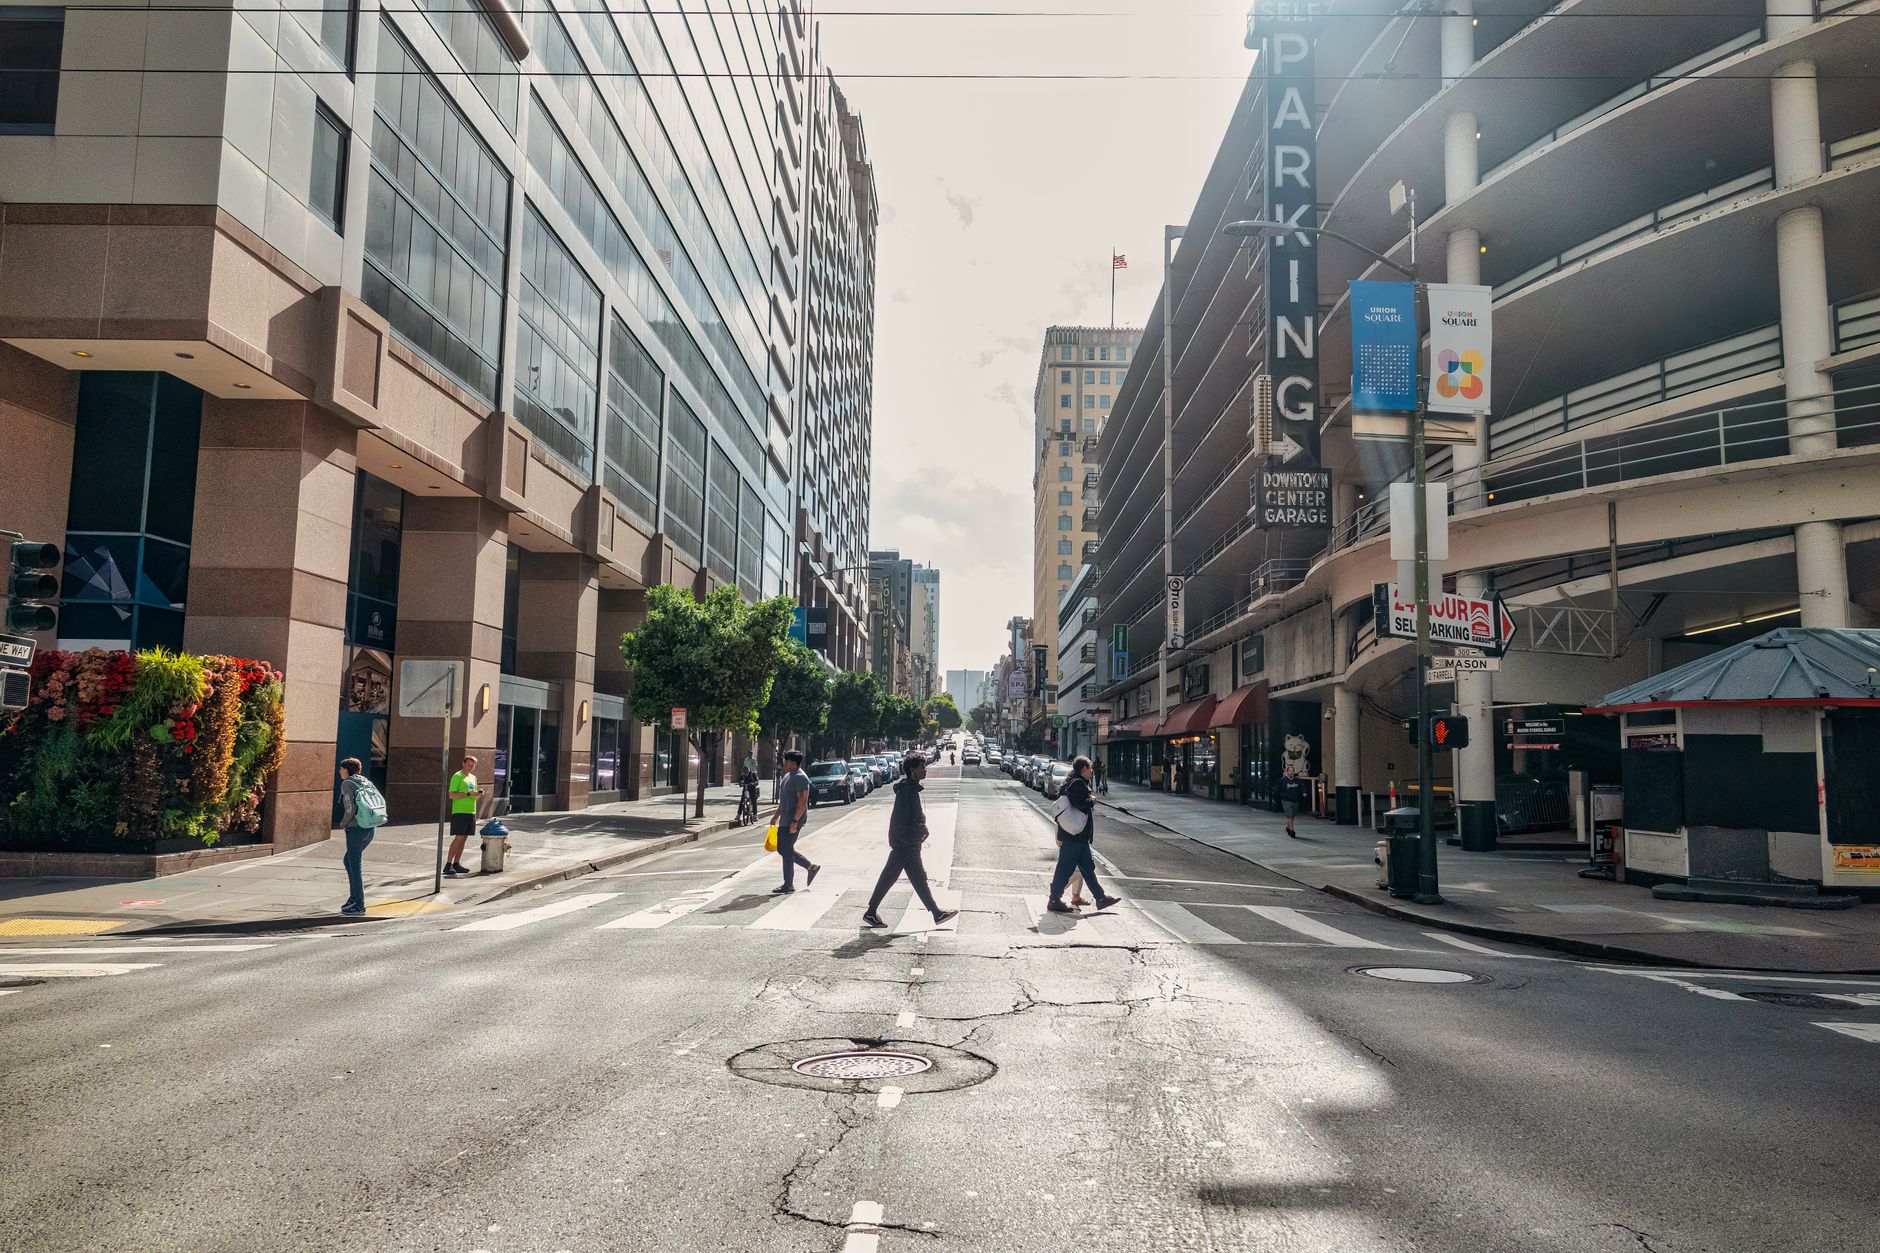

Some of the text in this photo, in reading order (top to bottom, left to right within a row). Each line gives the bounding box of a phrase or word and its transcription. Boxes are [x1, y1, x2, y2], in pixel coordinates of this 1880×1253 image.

[1260, 1, 1320, 22] SELF
[1273, 32, 1313, 421] PARKING
[1370, 306, 1397, 314] UNION
[1447, 310, 1473, 318] UNION
[1364, 314, 1403, 324] SQUARE
[1441, 317, 1479, 328] SQUARE
[1263, 471, 1329, 488] DOWNTOWN
[1265, 490, 1327, 506] CENTER
[1265, 508, 1328, 524] GARAGE
[1429, 597, 1469, 621] OUR
[1395, 616, 1417, 633] SEL
[11, 644, 29, 658] WAY
[1444, 659, 1487, 669] MASON
[1428, 670, 1454, 681] O'FARRELL
